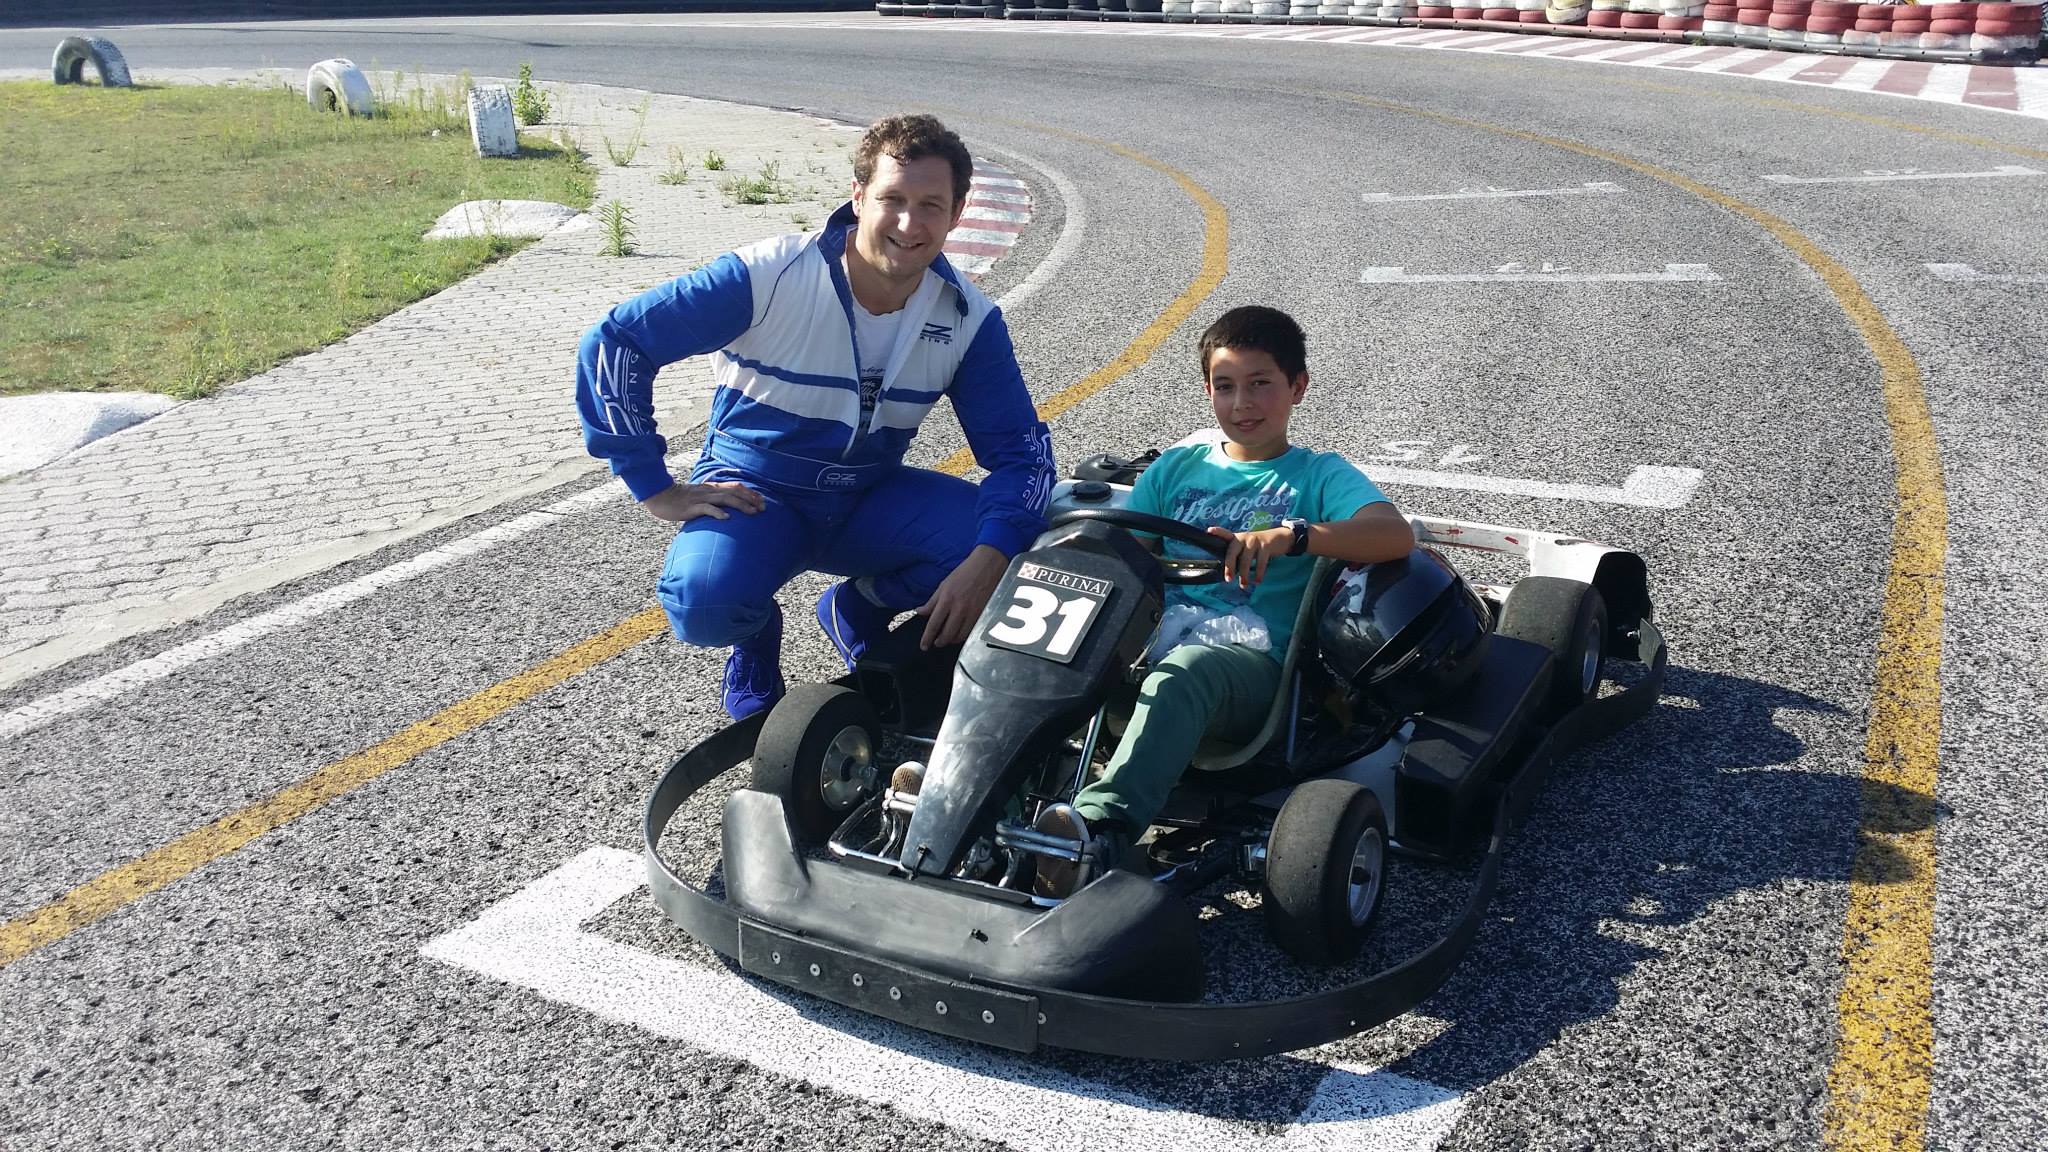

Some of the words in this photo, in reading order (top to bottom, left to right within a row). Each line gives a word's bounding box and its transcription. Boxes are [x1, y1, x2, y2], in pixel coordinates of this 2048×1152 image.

[826, 472, 857, 481] OZ
[1022, 433, 1044, 501] RACING
[1036, 568, 1101, 594] PURINA
[988, 585, 1097, 656] 31
